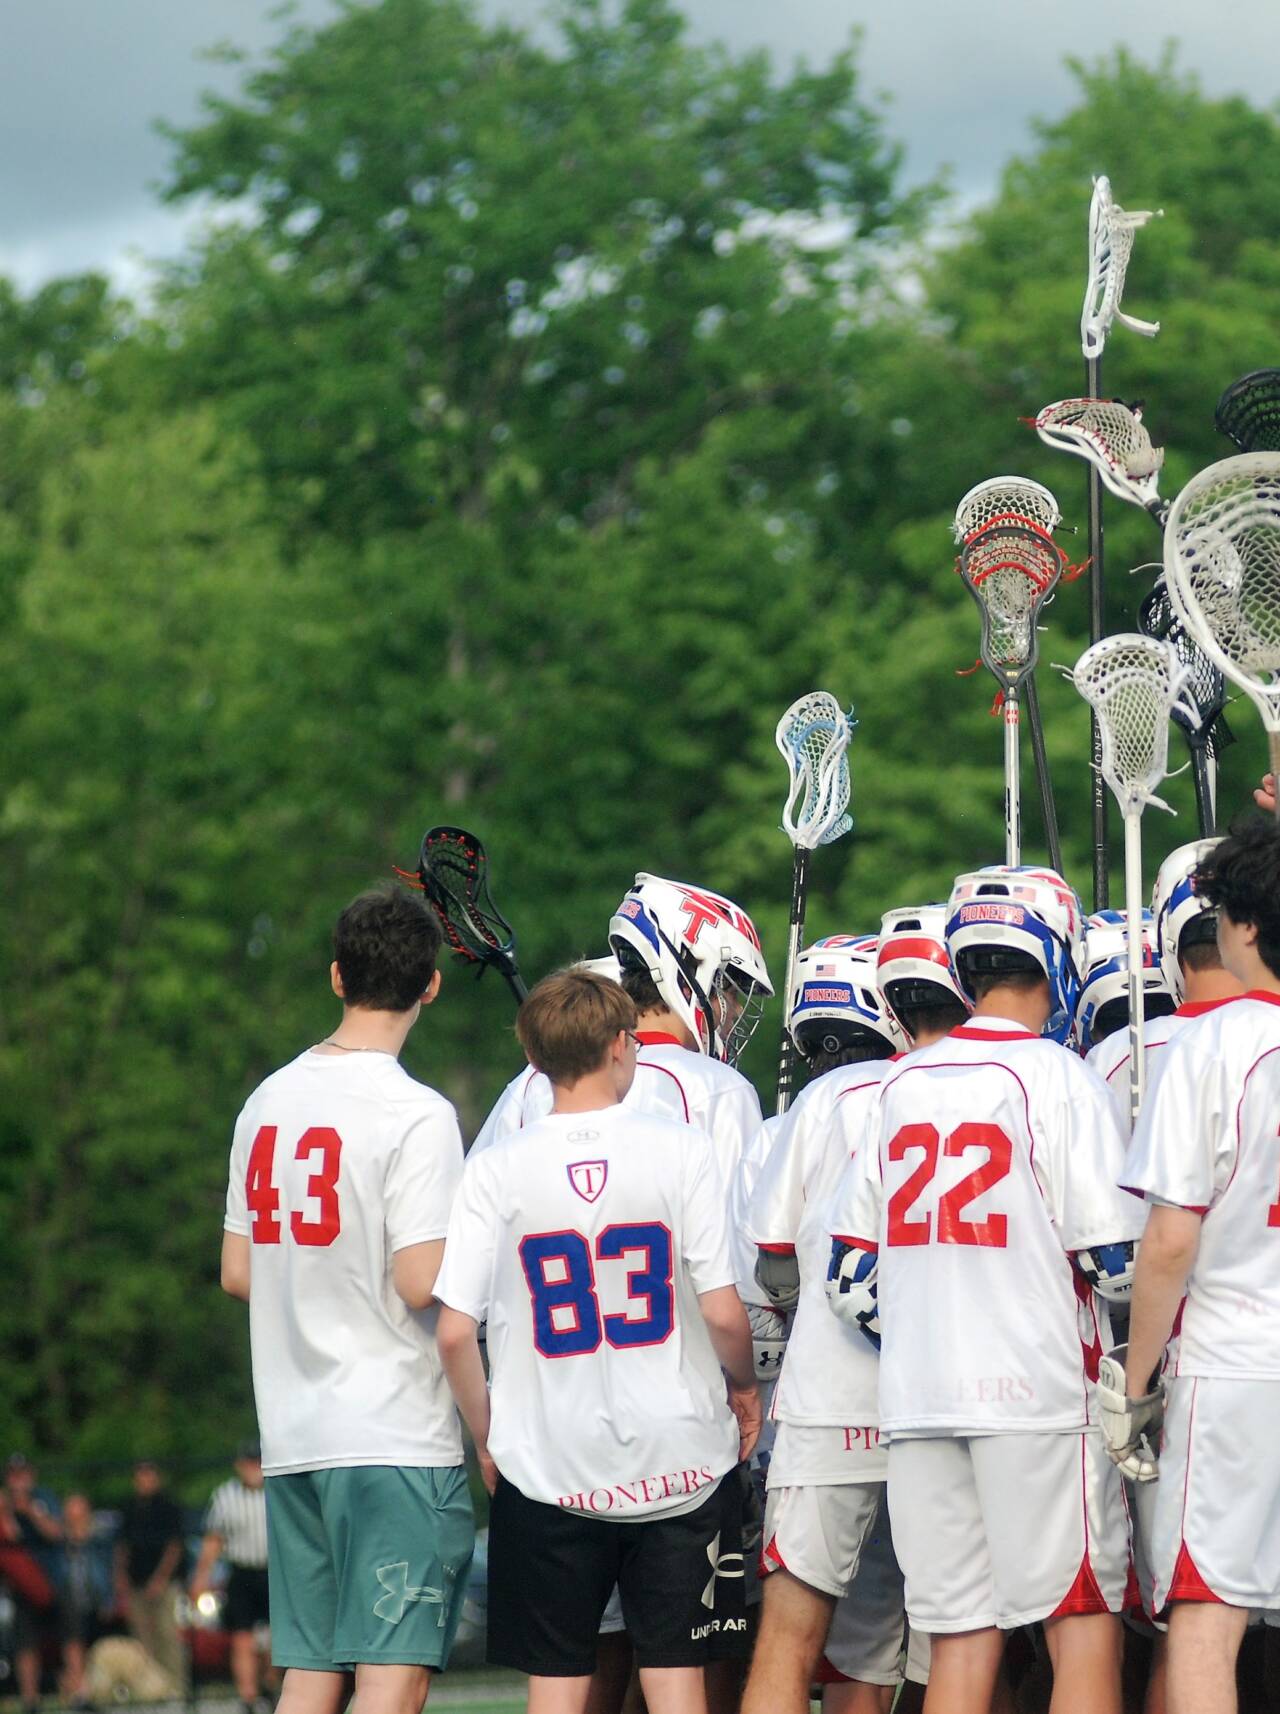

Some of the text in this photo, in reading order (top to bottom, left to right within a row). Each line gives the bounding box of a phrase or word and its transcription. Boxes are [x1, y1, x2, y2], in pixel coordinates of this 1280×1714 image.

[245, 1125, 343, 1246] 43
[887, 1122, 1013, 1248] 22
[517, 1220, 675, 1359] 83
